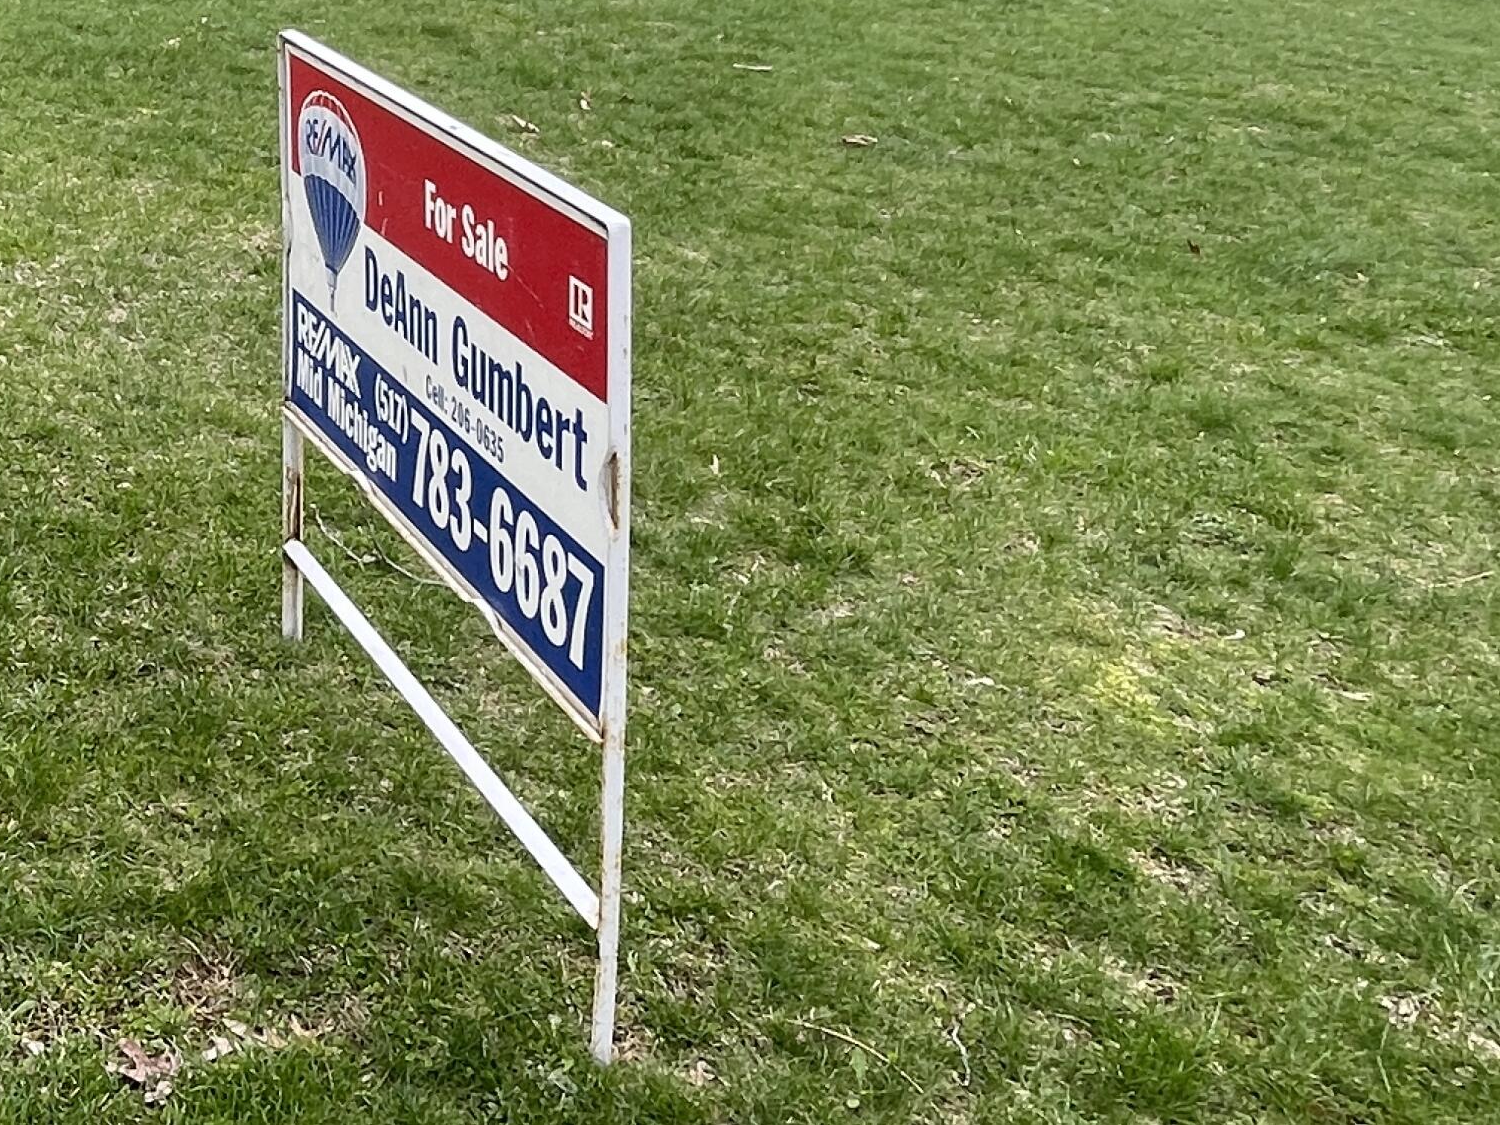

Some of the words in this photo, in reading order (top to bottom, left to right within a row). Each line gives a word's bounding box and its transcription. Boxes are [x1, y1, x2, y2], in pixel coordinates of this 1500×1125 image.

[424, 179, 456, 244] For
[461, 204, 509, 281] Sale
[297, 301, 361, 399] RE/MAX
[365, 245, 438, 365] DeAnn
[452, 315, 588, 492] Gumbert
[297, 347, 323, 409] Mid
[327, 376, 398, 483] Michigan
[426, 374, 448, 415] Cell:
[451, 395, 505, 464] 206-0635
[374, 373, 409, 445] (517)
[411, 406, 594, 671] 783-6687
